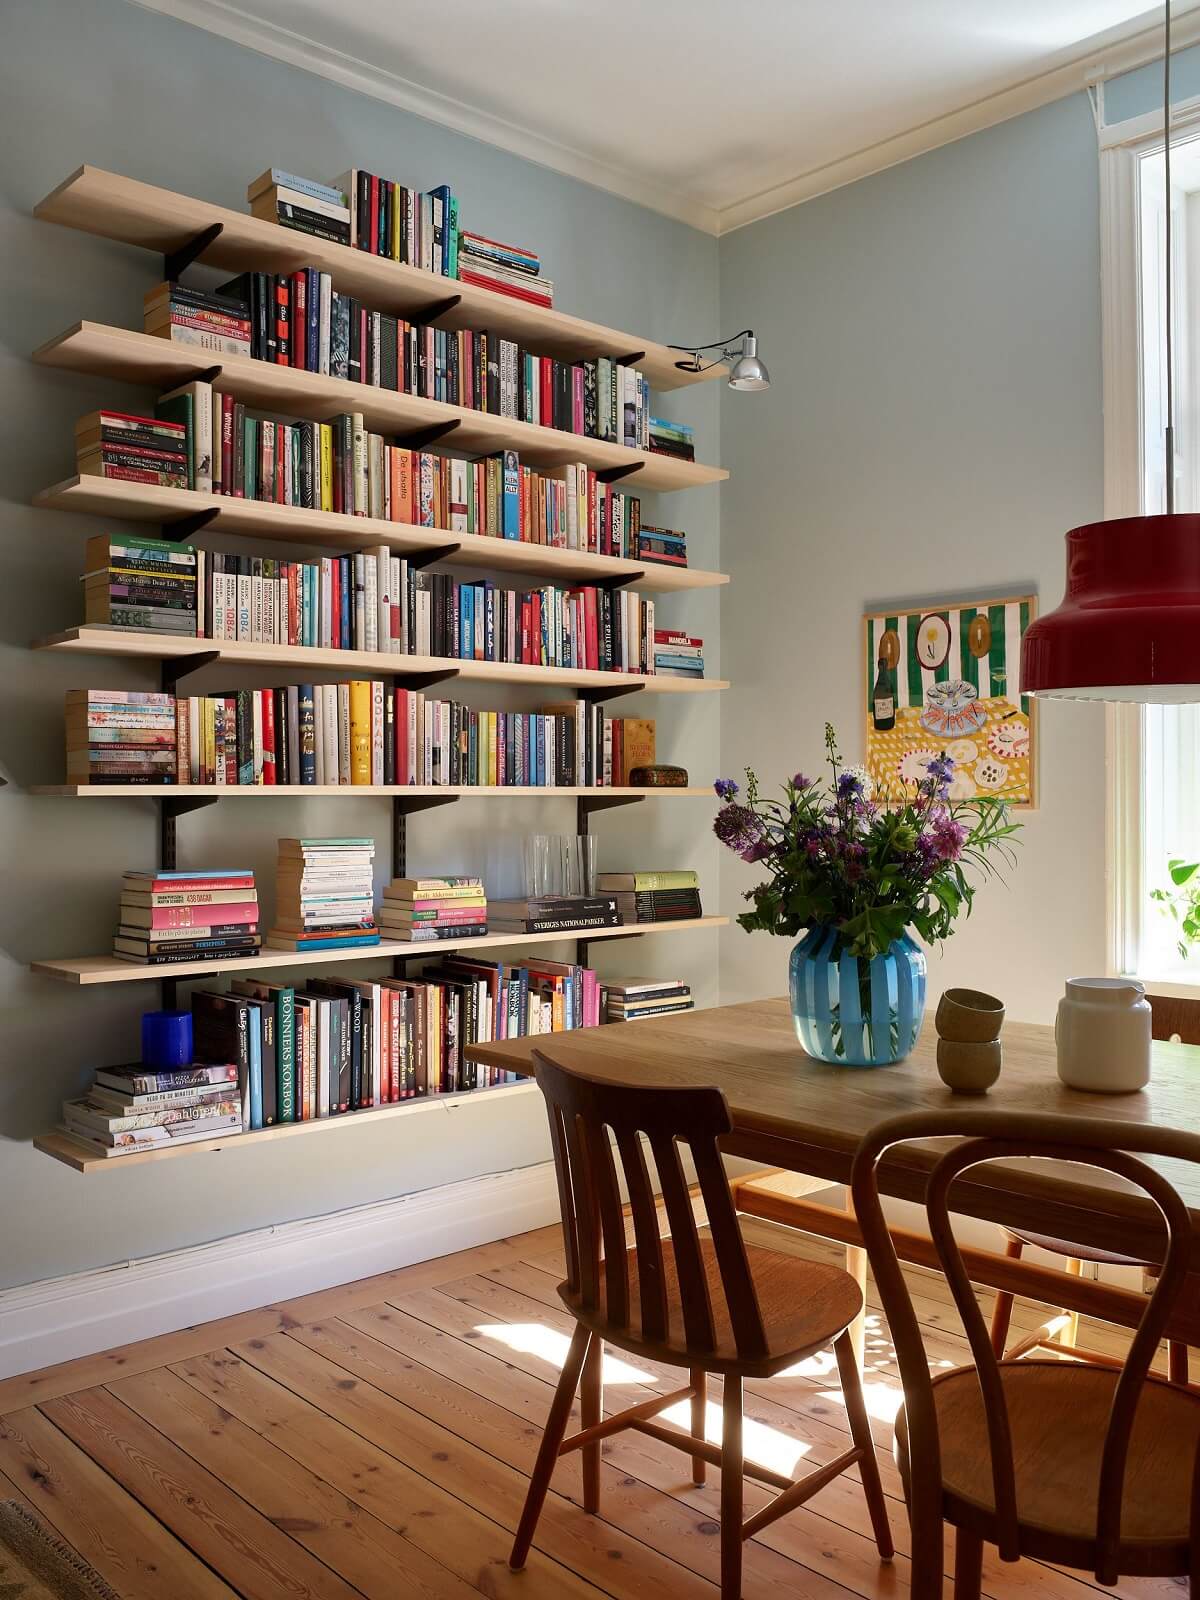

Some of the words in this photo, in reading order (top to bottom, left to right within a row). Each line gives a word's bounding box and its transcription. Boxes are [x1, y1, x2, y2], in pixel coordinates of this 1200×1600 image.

[400, 456, 408, 468] De
[226, 608, 235, 632] 1Q84
[240, 608, 248, 633] 1Q84
[669, 636, 691, 645] MANDELA
[197, 894, 213, 903] DAGAR
[534, 920, 560, 930] SVERIGES
[560, 917, 605, 928] NATIONALPARKER
[195, 940, 226, 948] PERSEPOLIS
[282, 996, 292, 1061] BONNIERS
[392, 1053, 400, 1088] BARBECUE
[174, 1090, 194, 1099] MINUTER
[282, 1063, 292, 1117] KOKBOK
[168, 1105, 219, 1123] Dahlgren
